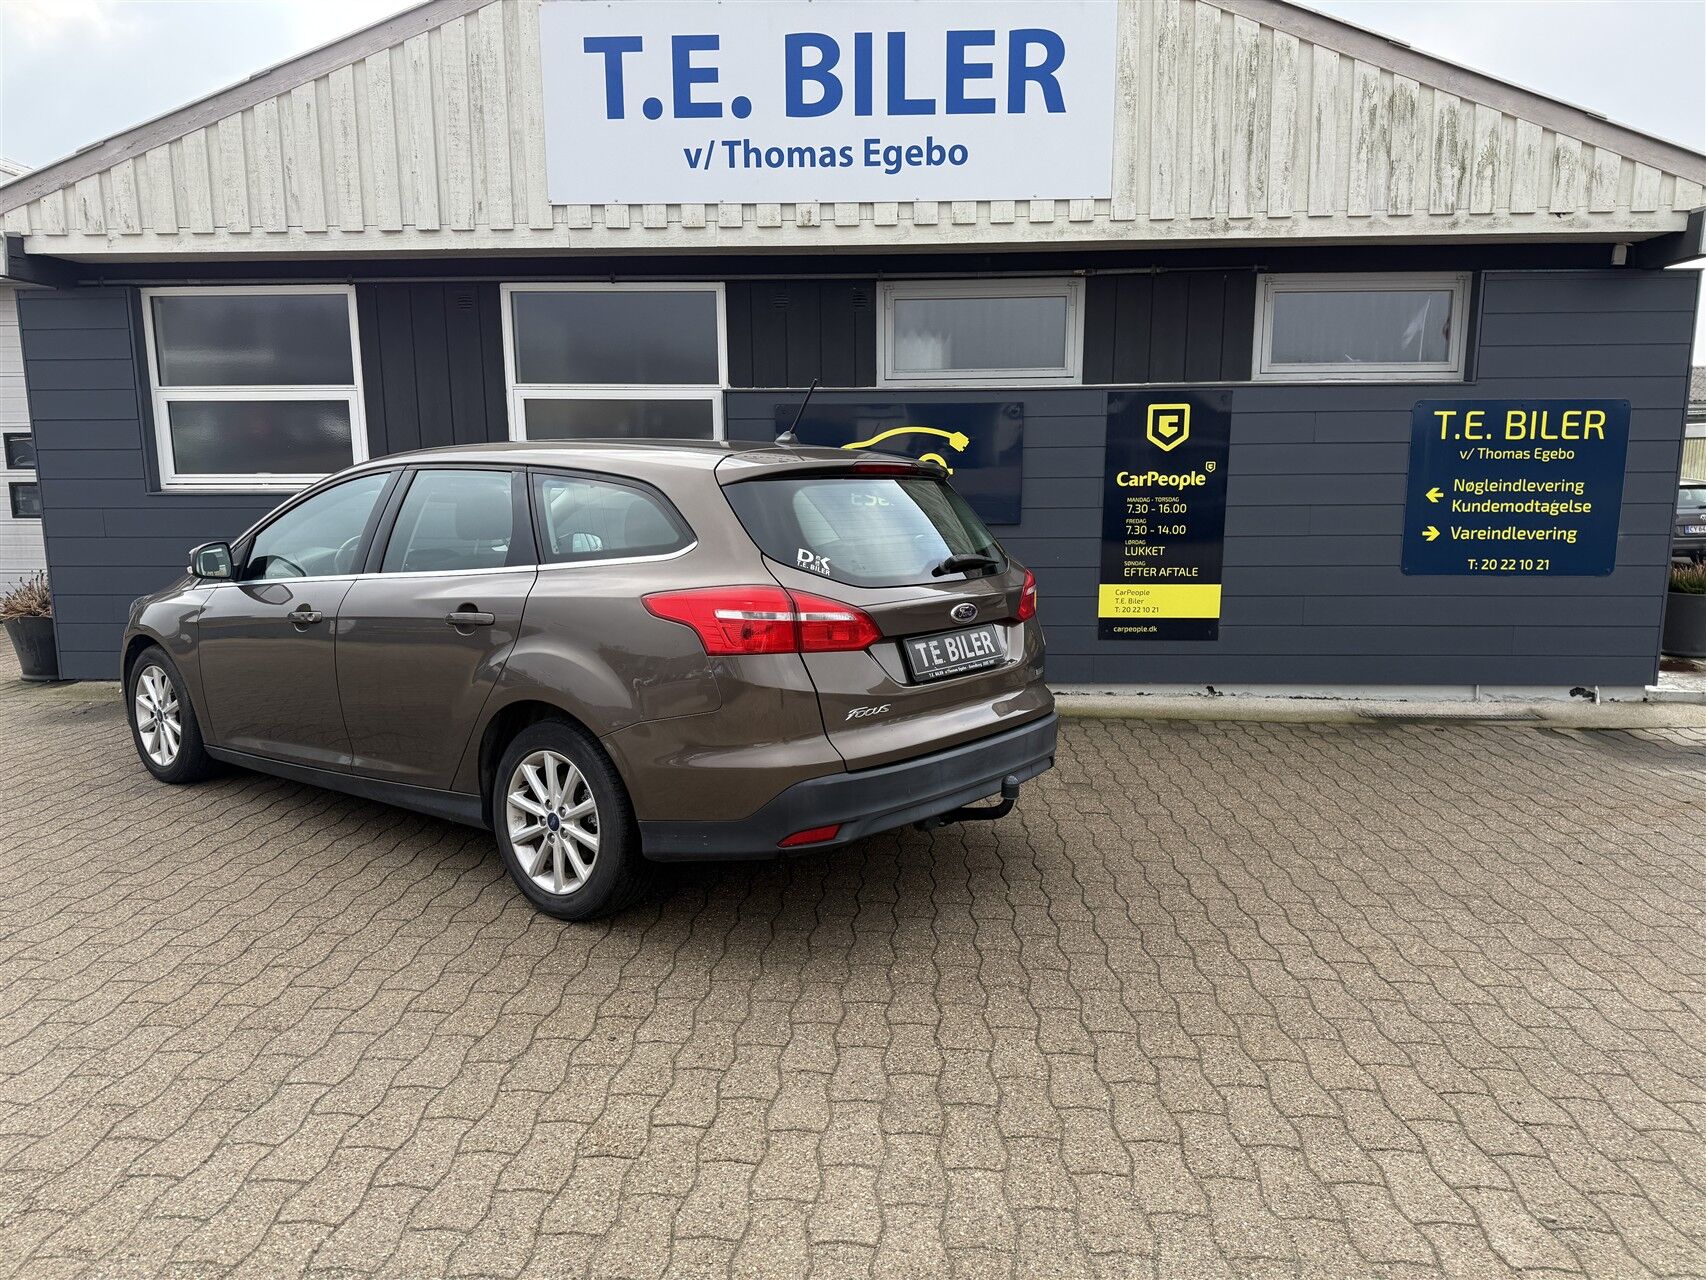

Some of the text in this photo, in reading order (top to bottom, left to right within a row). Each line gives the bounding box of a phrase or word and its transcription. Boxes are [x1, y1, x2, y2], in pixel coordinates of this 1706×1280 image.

[583, 27, 1067, 121] T.E. BILER
[683, 136, 969, 174] v/ Thomas Egebo
[1434, 410, 1606, 440] T.E. BILER
[1460, 448, 1575, 462] v/ Thomas Egebo
[1116, 471, 1206, 490] CarPeople
[1454, 479, 1584, 496] Nøgleindlevering
[1127, 504, 1148, 514] 7.30
[1159, 504, 1187, 514] 16.00
[1452, 500, 1592, 516] Kundemodtagelse
[1126, 526, 1147, 534] 7.30
[1158, 525, 1186, 534] 14.00
[1450, 526, 1578, 544] Vareindlevering
[1124, 546, 1166, 556] LUKKET
[797, 560, 830, 576] T.E. BILER
[1124, 568, 1198, 576] EFTER AFTALE
[1468, 560, 1550, 570] T: 20 22 10 21
[944, 632, 996, 662] BILER
